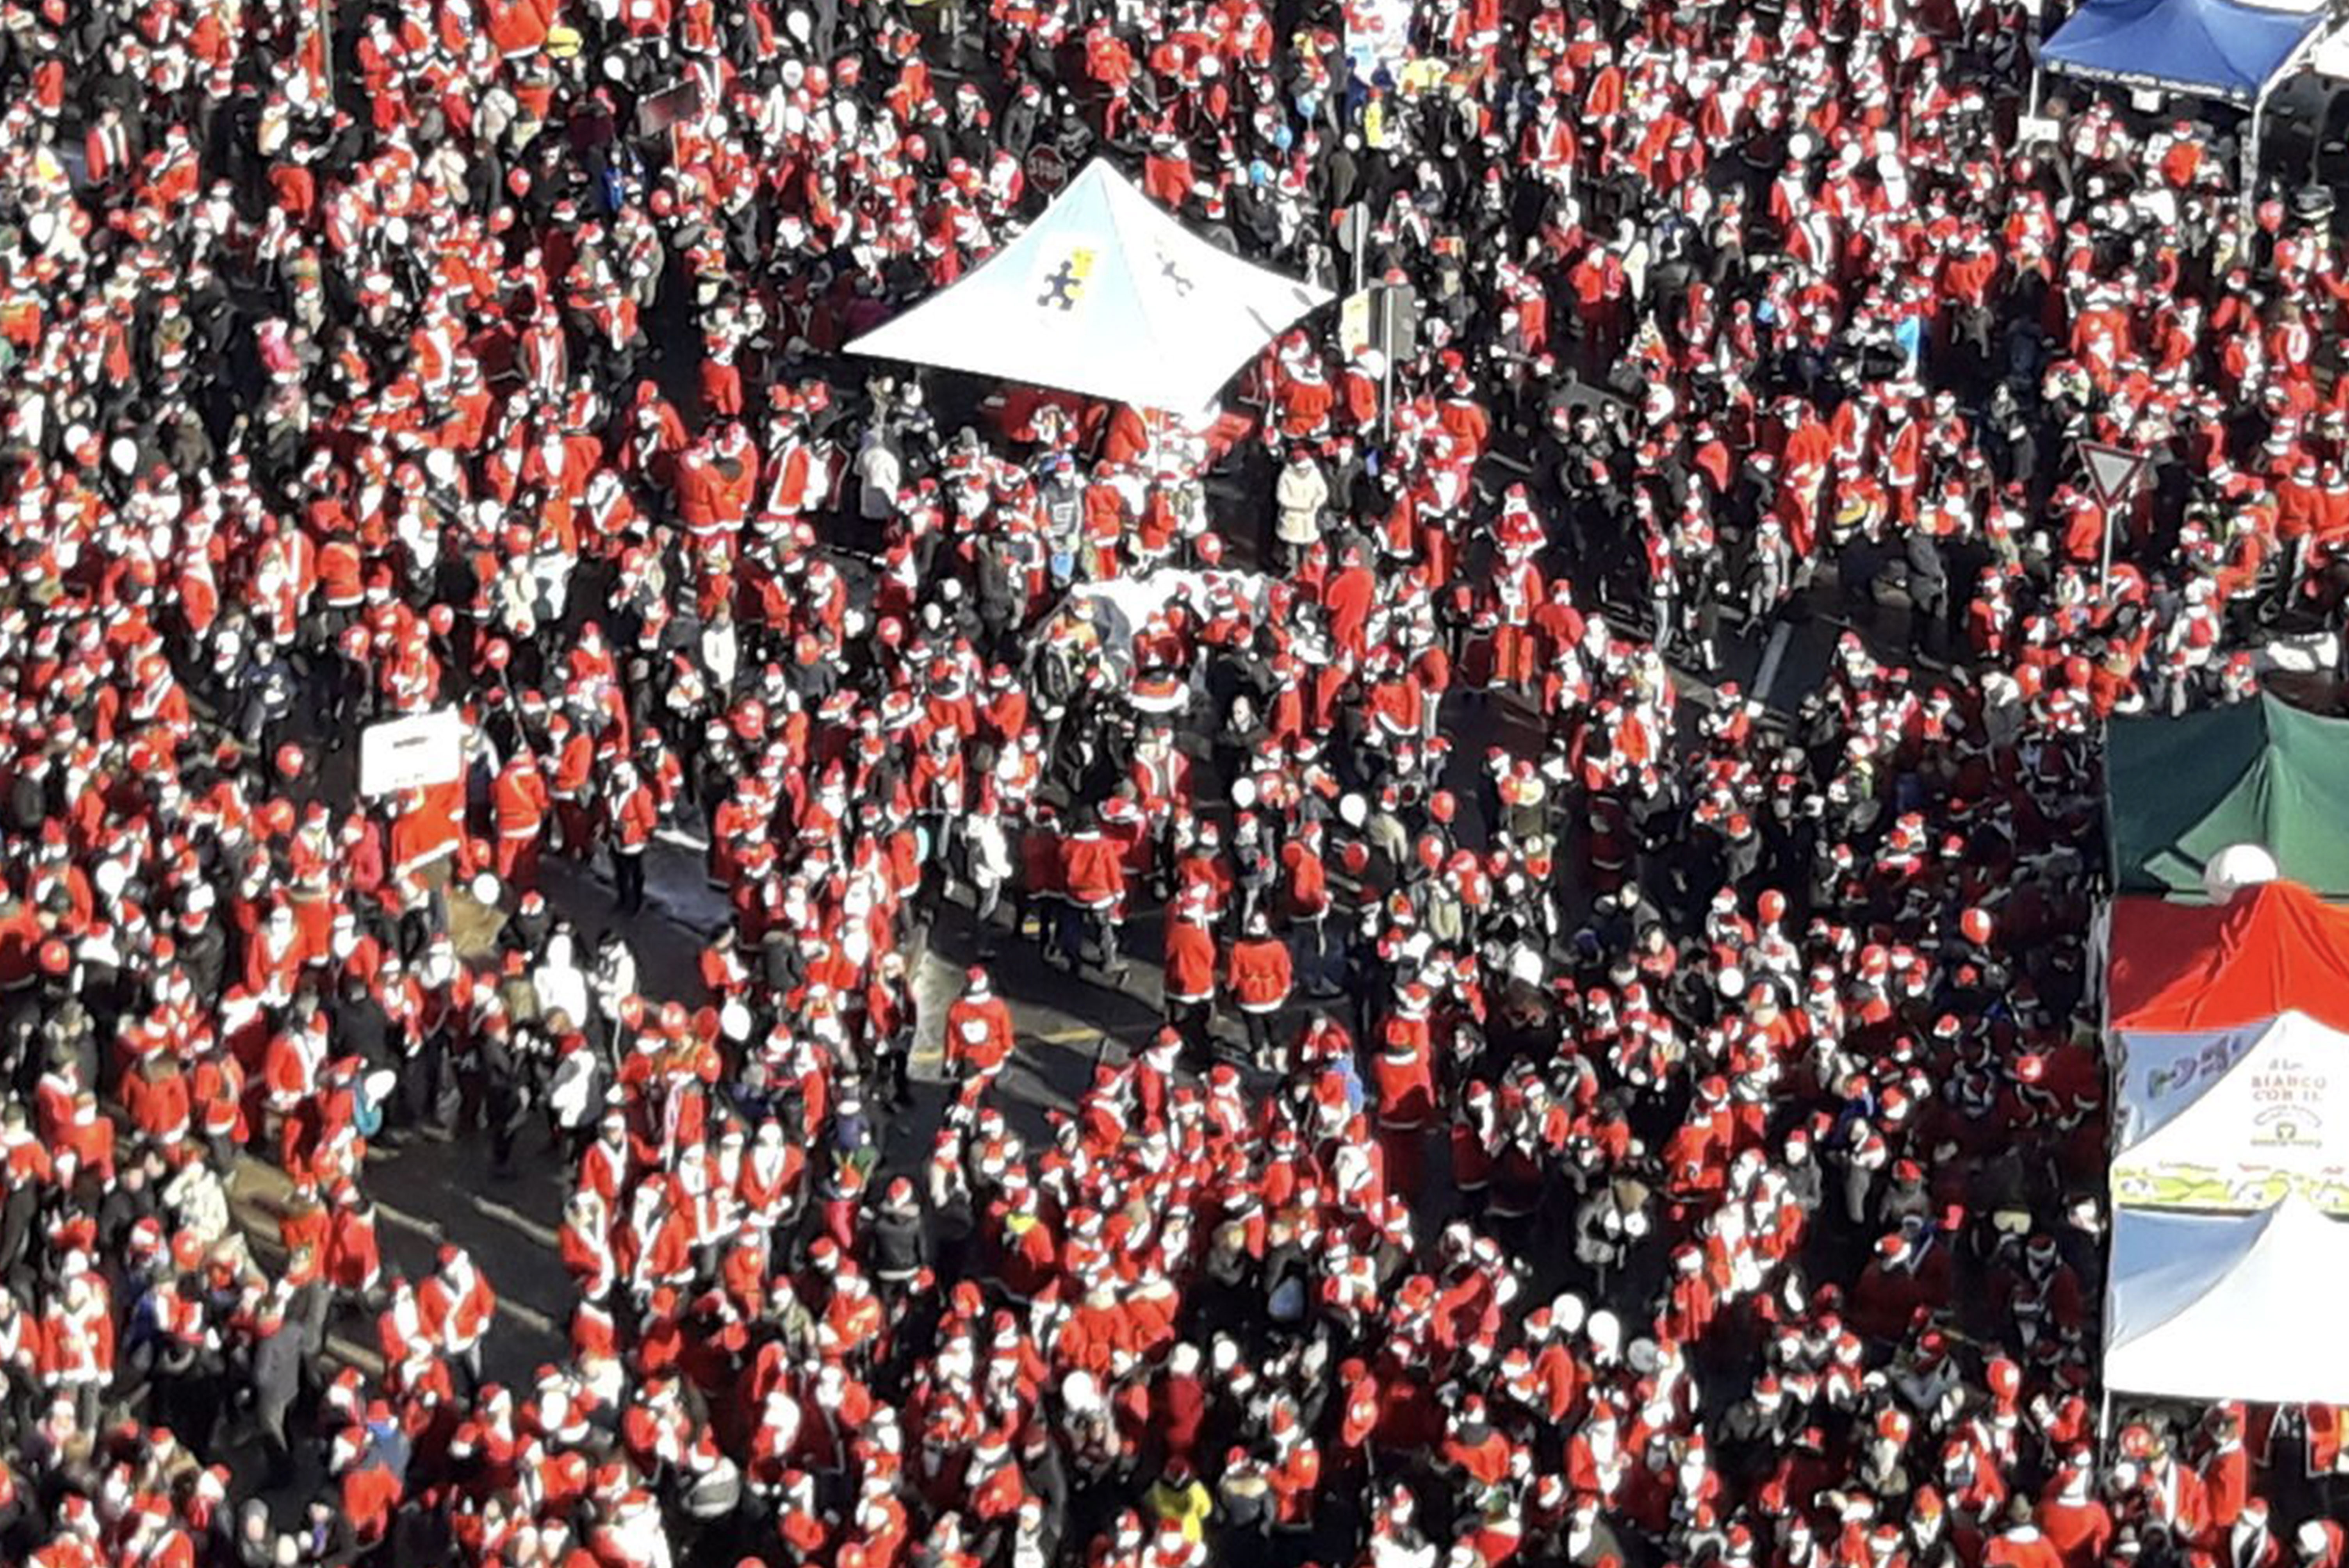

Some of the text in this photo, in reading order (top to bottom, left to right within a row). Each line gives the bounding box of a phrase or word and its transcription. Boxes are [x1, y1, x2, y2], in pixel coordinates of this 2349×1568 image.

[1028, 157, 1062, 180] STOP
[2251, 1074, 2327, 1089] BIANCO
[2253, 1090, 2293, 1101] CON
